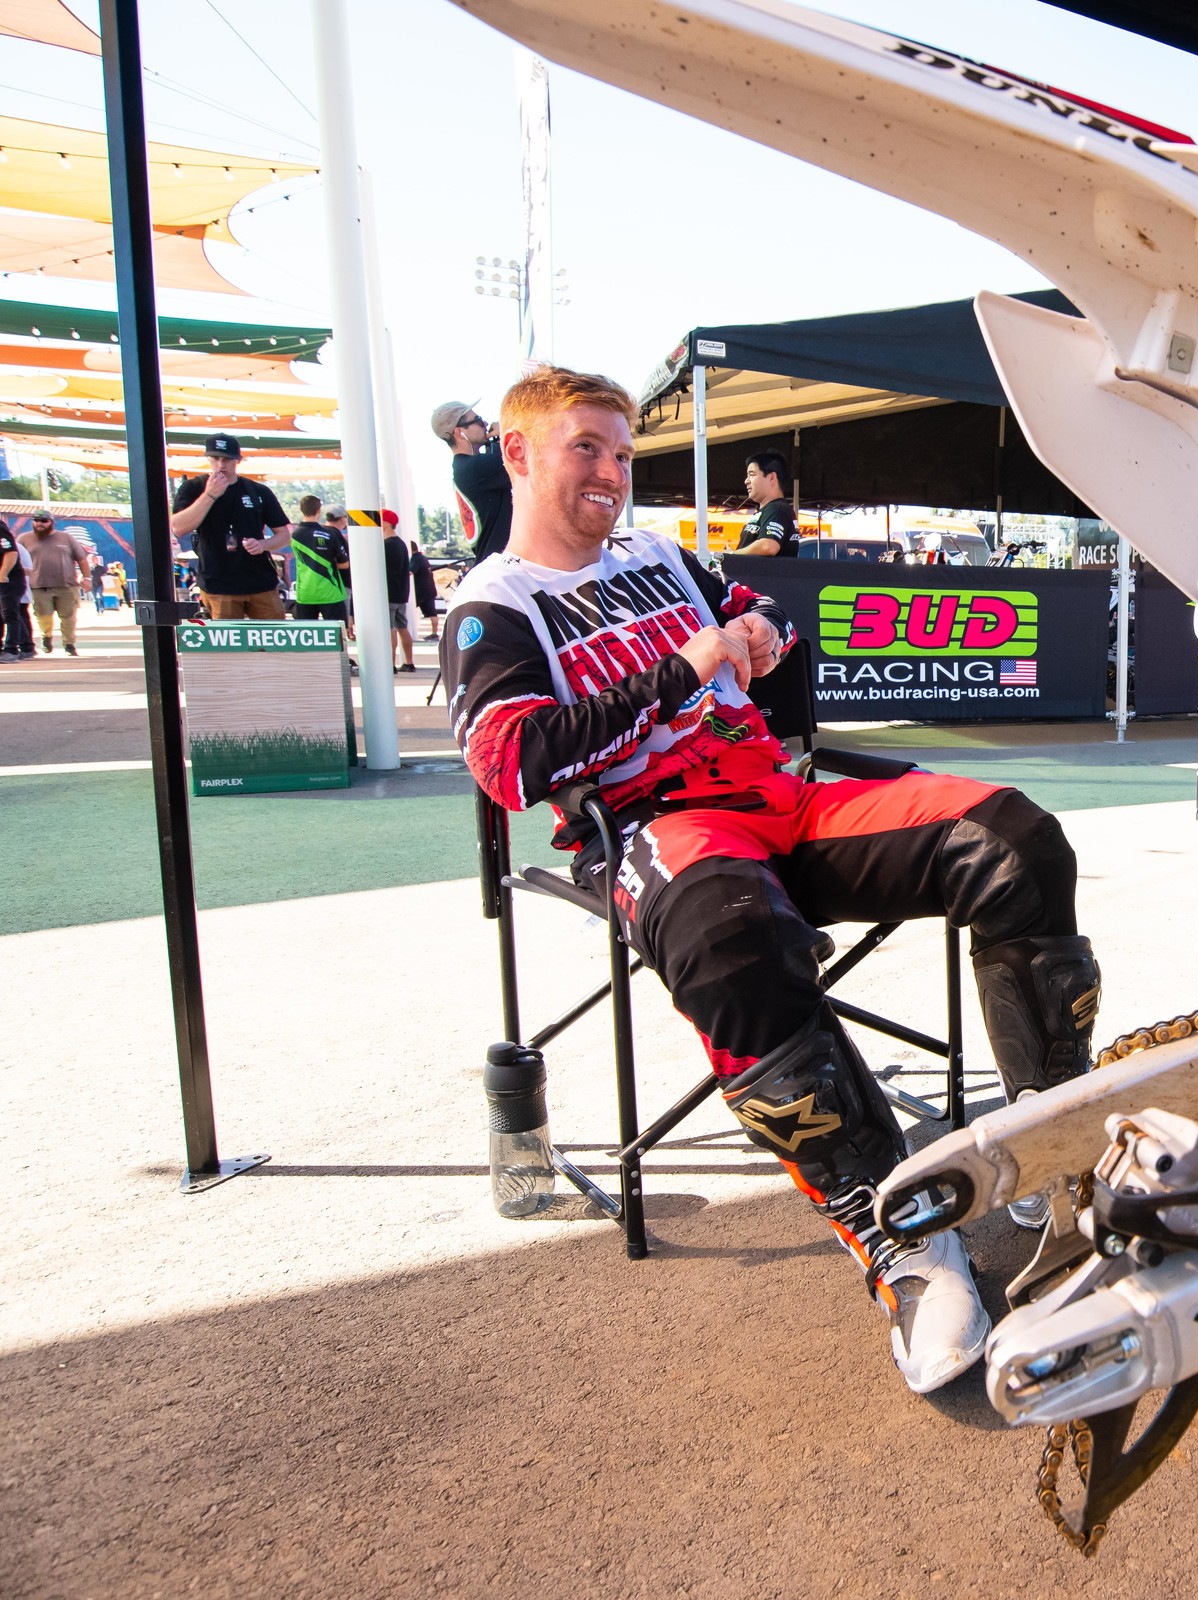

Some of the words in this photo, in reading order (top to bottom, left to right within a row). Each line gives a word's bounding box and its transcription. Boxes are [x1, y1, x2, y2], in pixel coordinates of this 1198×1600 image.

[1078, 544, 1107, 566] RACE
[846, 592, 1020, 650] BUD
[208, 629, 241, 647] WE
[247, 629, 337, 647] RECYCLE
[817, 660, 995, 684] RACING
[815, 685, 1041, 701] www.budracing-usa.com
[200, 777, 244, 788] FAIRPLEX
